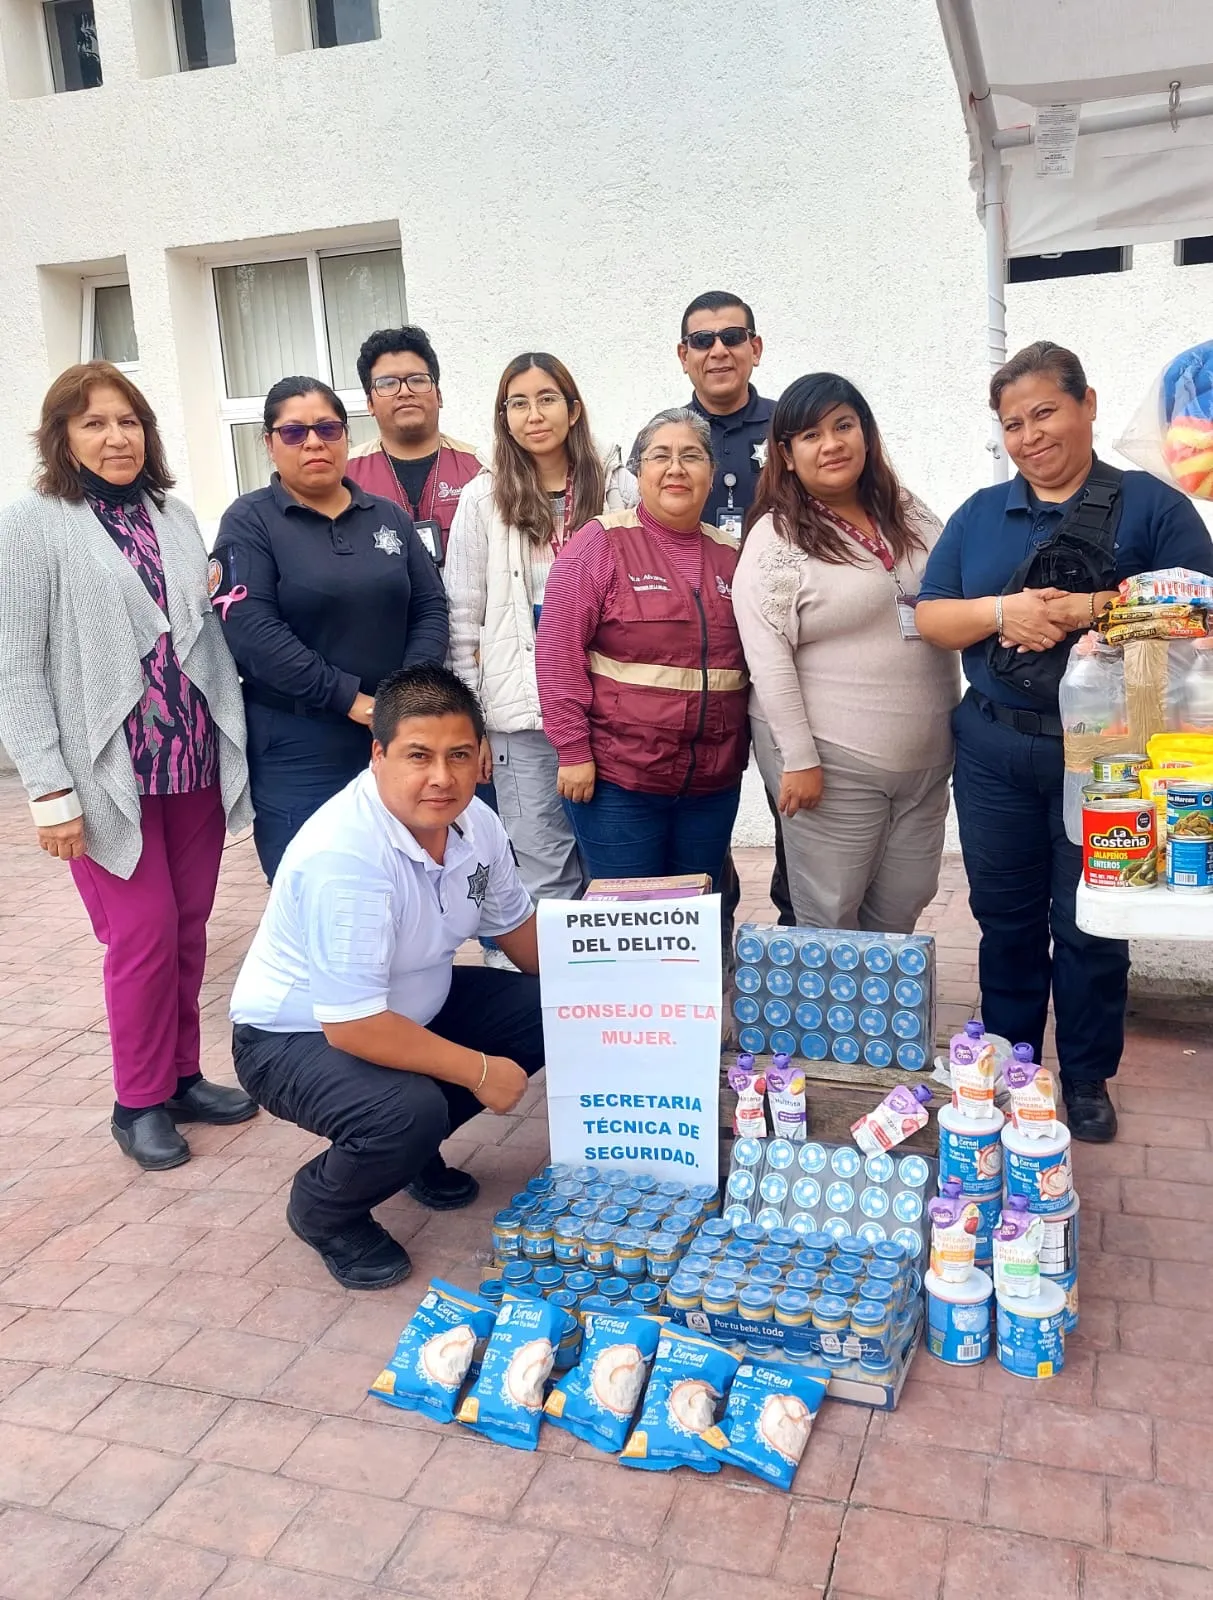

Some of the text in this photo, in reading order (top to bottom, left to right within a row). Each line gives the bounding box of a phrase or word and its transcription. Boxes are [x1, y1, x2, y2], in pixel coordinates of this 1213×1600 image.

[1113, 829, 1127, 838] La
[1093, 835, 1147, 848] Costeña
[1093, 850, 1128, 860] JALAPEÑOS
[1093, 860, 1121, 870] ENTEROS
[566, 907, 700, 928] PREVENCIÓN
[572, 936, 697, 953] DEL DELITO.
[557, 1003, 717, 1020] CONSEJO DE LA
[602, 1031, 677, 1046] MUJER.
[580, 1094, 702, 1112] SECRETARIA
[583, 1117, 700, 1140] TÉCNICA DE
[960, 1138, 979, 1147] Cereal
[584, 1146, 700, 1169] SEGURIDAD.
[1020, 1158, 1040, 1168] Cereal
[414, 1311, 436, 1328] rroz
[513, 1308, 543, 1322] Cereal
[594, 1317, 630, 1330] Cereal
[714, 1318, 731, 1329] Por
[731, 1319, 740, 1331] tu
[762, 1326, 785, 1338] todo
[491, 1332, 513, 1343] rroz
[673, 1349, 709, 1365] Cereal
[756, 1367, 793, 1389] Cereal
